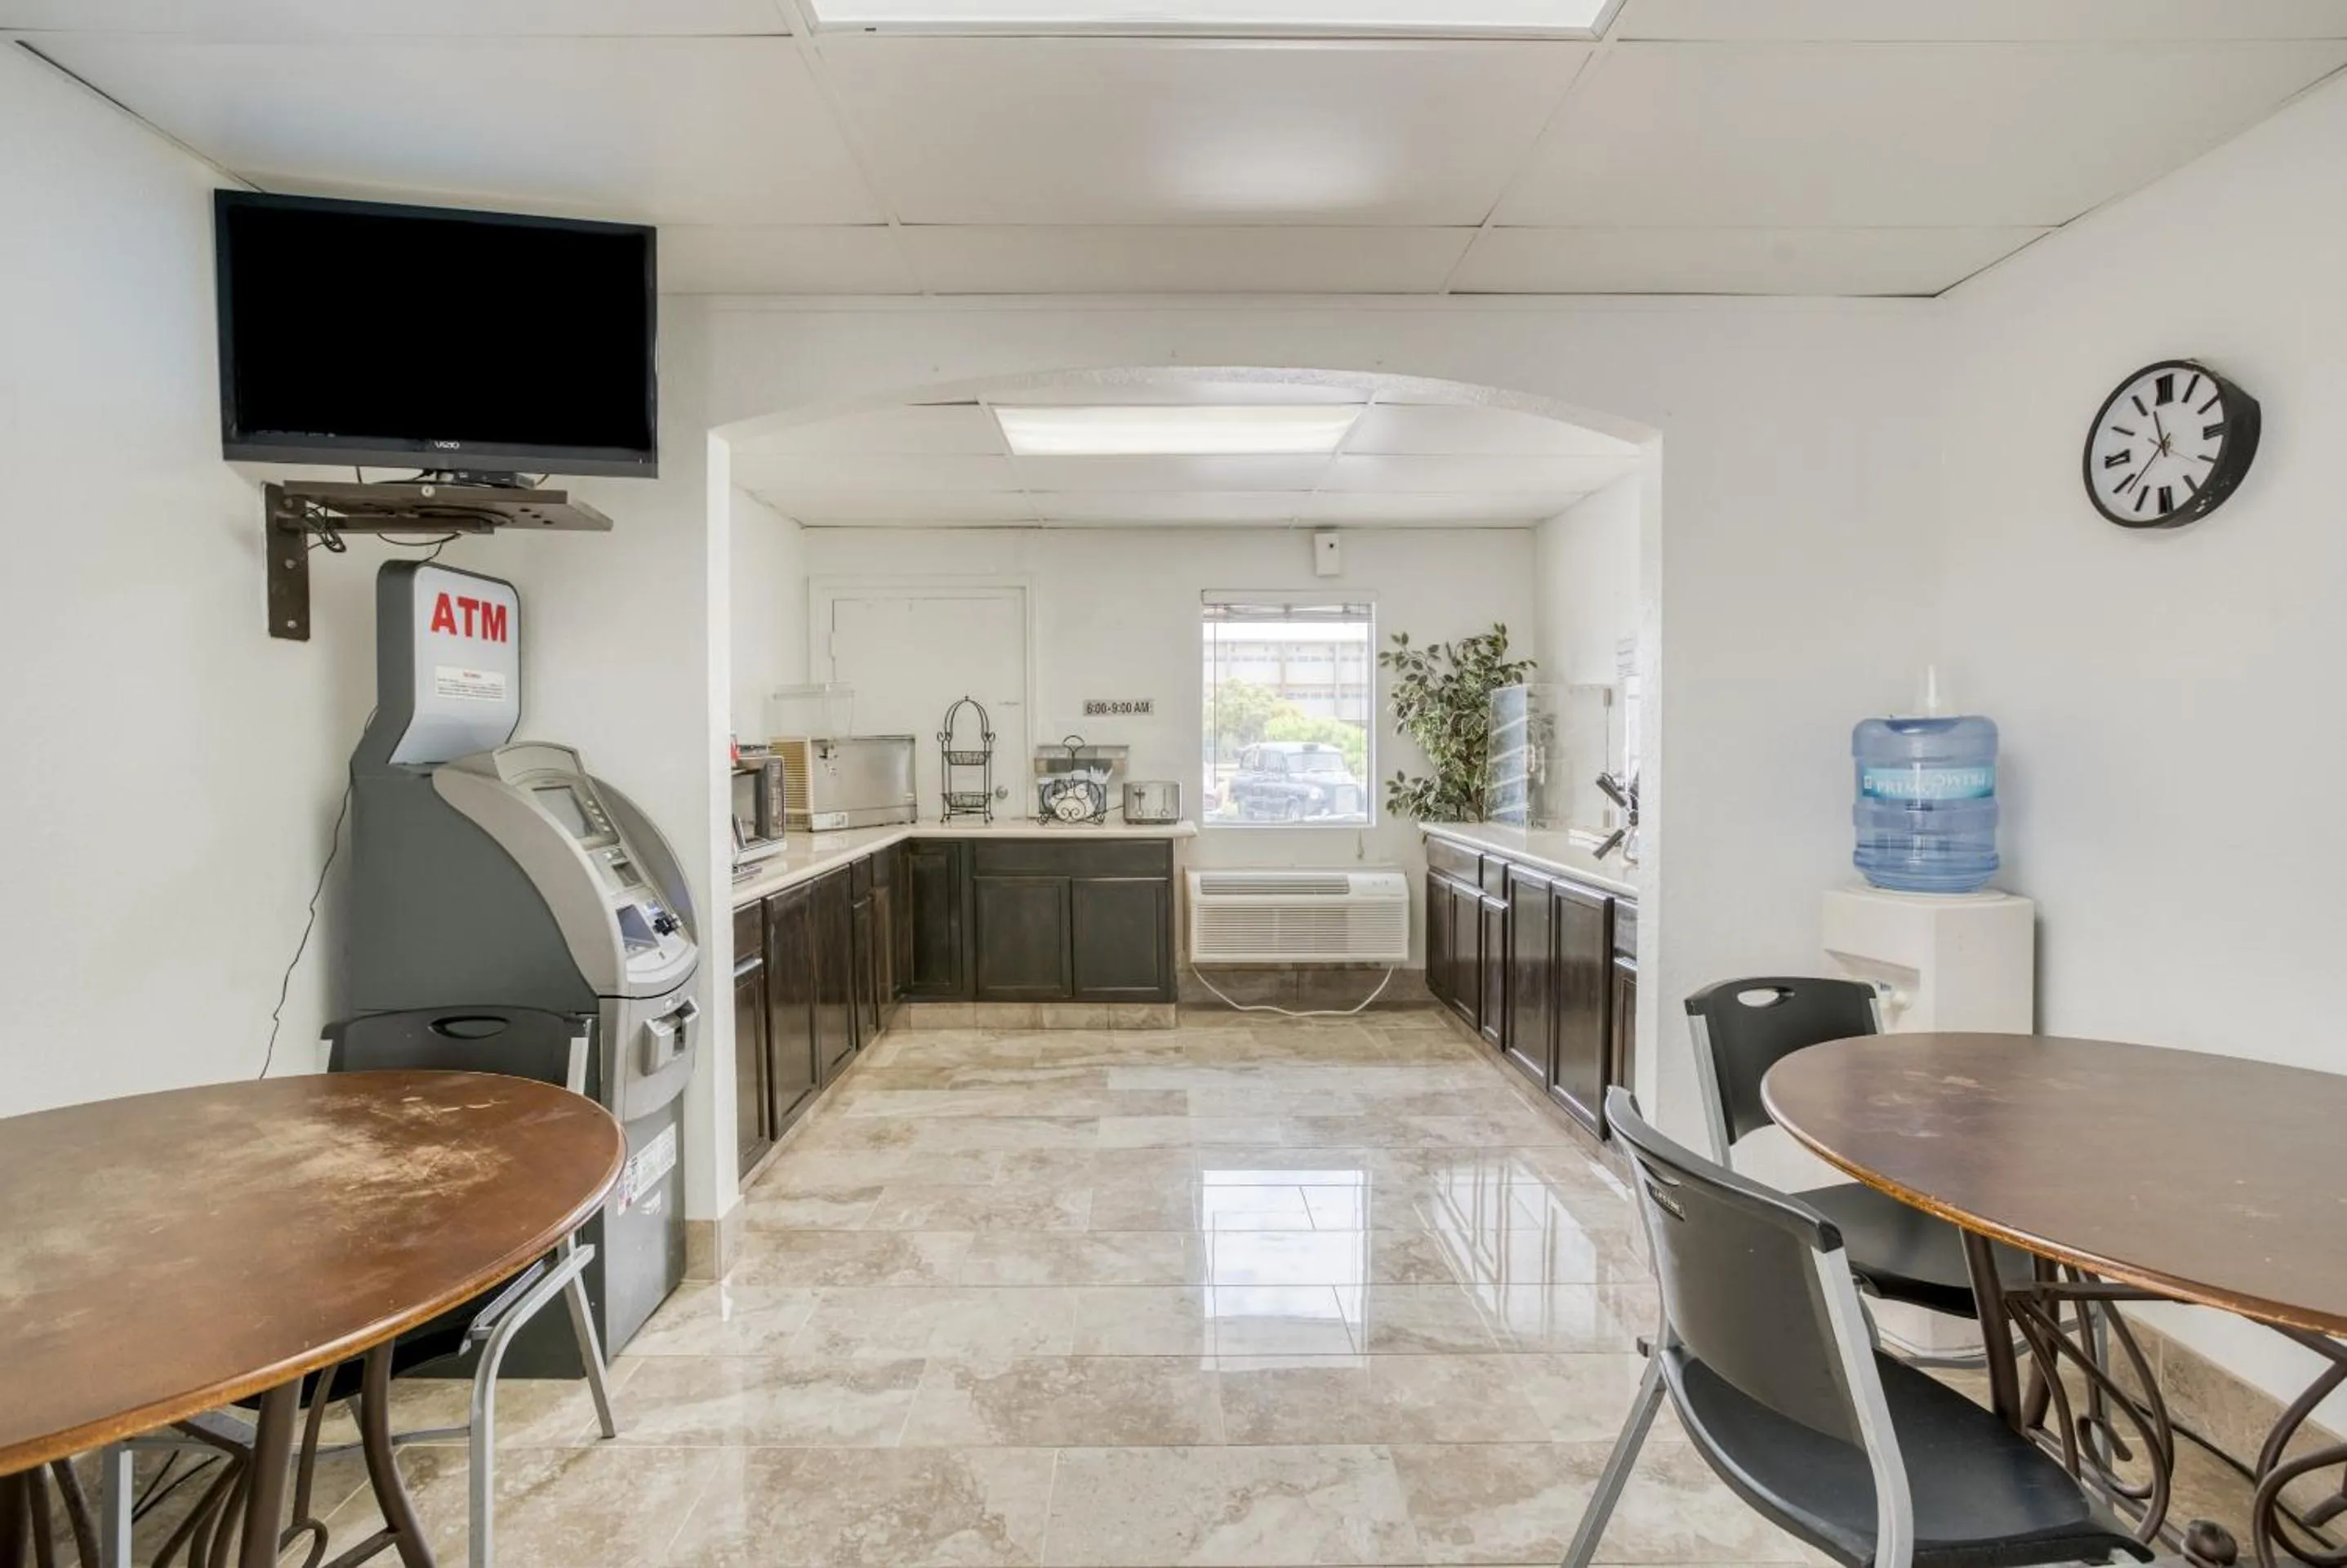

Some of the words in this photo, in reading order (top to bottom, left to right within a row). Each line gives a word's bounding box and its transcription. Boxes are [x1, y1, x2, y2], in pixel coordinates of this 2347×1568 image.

[430, 591, 507, 643] ATM
[1086, 702, 1133, 715] 6:00-9:00
[1134, 702, 1150, 713] AM
